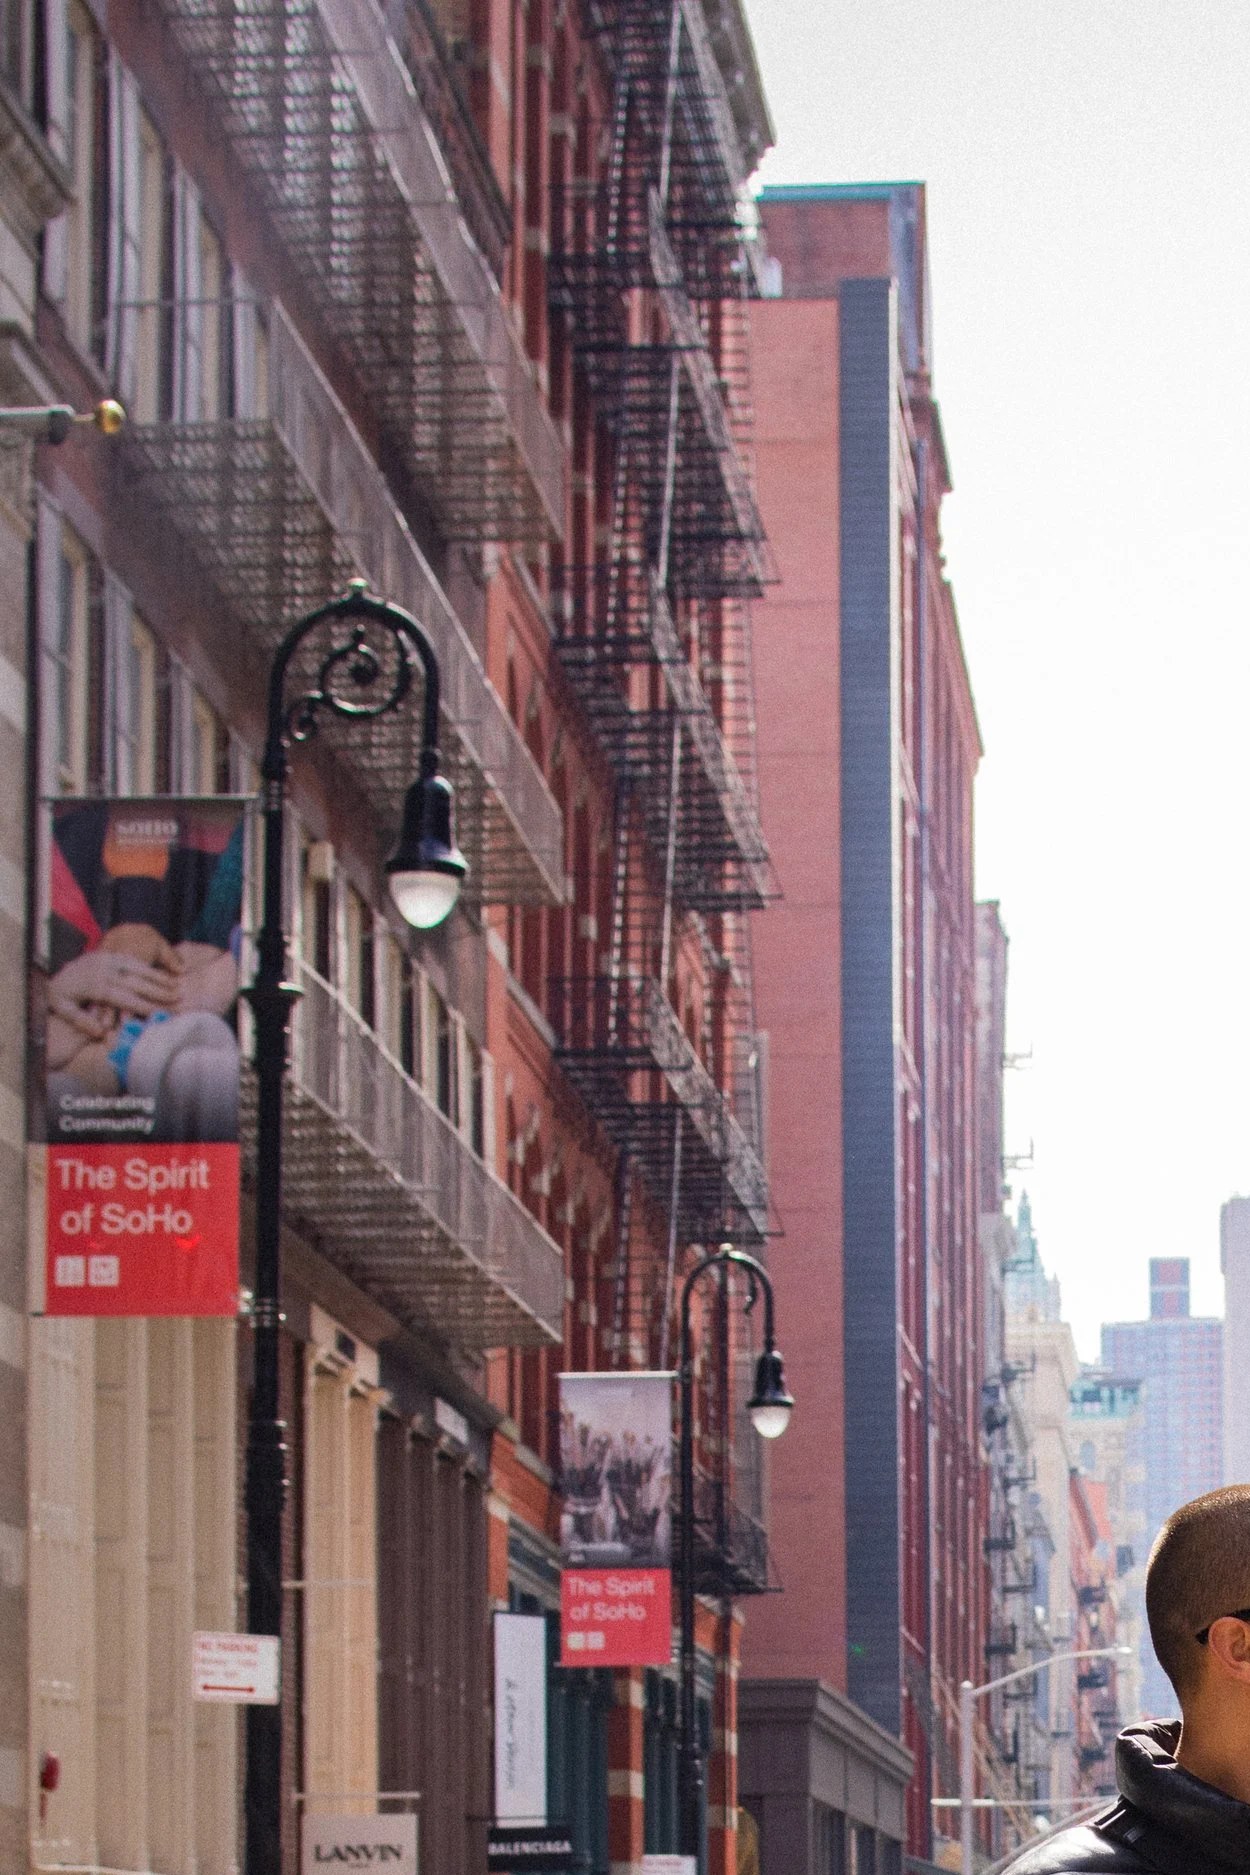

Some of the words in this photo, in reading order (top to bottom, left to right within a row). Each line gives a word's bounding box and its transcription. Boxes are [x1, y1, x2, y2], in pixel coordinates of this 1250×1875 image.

[59, 1095, 156, 1114] Celebrating
[59, 1116, 155, 1134] Community
[55, 1158, 117, 1190] The
[123, 1157, 209, 1197] Spirit
[59, 1202, 95, 1234] of
[100, 1202, 193, 1235] SoHo
[567, 1576, 602, 1597] The
[605, 1575, 655, 1598] Spirit
[569, 1602, 591, 1622] of
[593, 1601, 647, 1622] SoHo
[313, 1844, 403, 1863] LANVIN
[488, 1840, 572, 1855] BALENCIAGA
